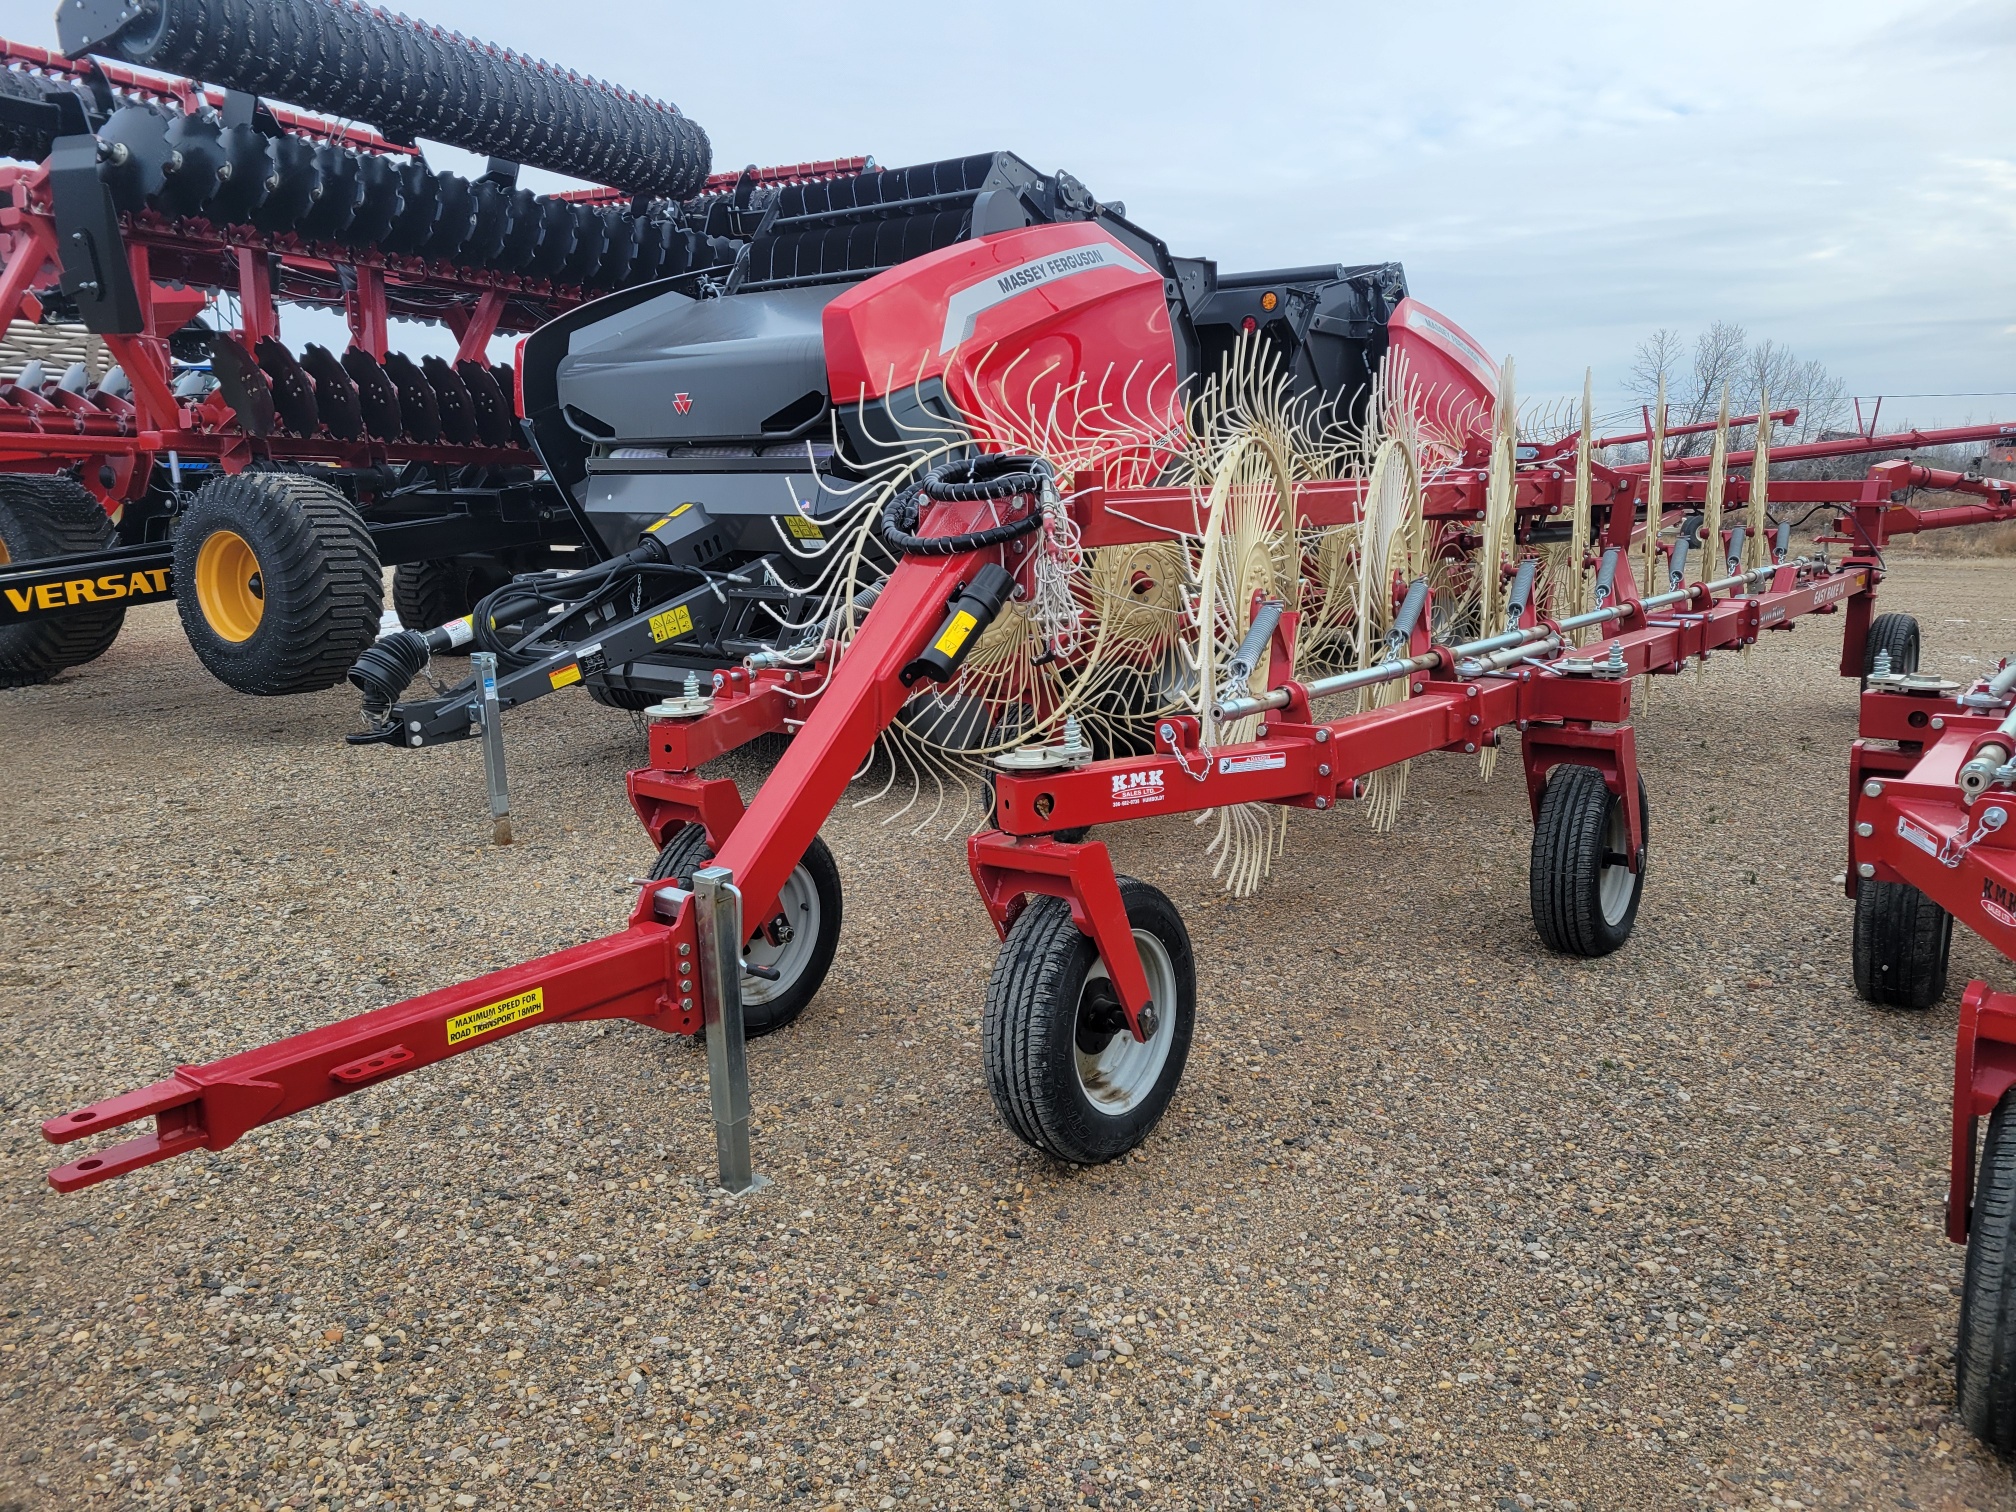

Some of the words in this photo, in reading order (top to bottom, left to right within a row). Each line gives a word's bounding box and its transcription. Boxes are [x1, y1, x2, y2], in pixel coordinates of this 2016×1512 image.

[997, 263, 1048, 294] MASSEY
[1046, 249, 1105, 275] FERGUSON
[4, 568, 171, 613] VERSAT
[1813, 586, 1828, 605] EASY
[1826, 583, 1840, 600] RAKE
[1112, 769, 1164, 792] K.M.K
[1122, 789, 1142, 798] SALES
[450, 1028, 471, 1042] ROAD
[473, 1012, 516, 1034] TRANSPORT
[517, 1002, 542, 1017] 18MPH
[455, 1007, 496, 1028] MAXIMUM
[497, 999, 521, 1014] SPEED
[522, 993, 537, 1005] FOR
